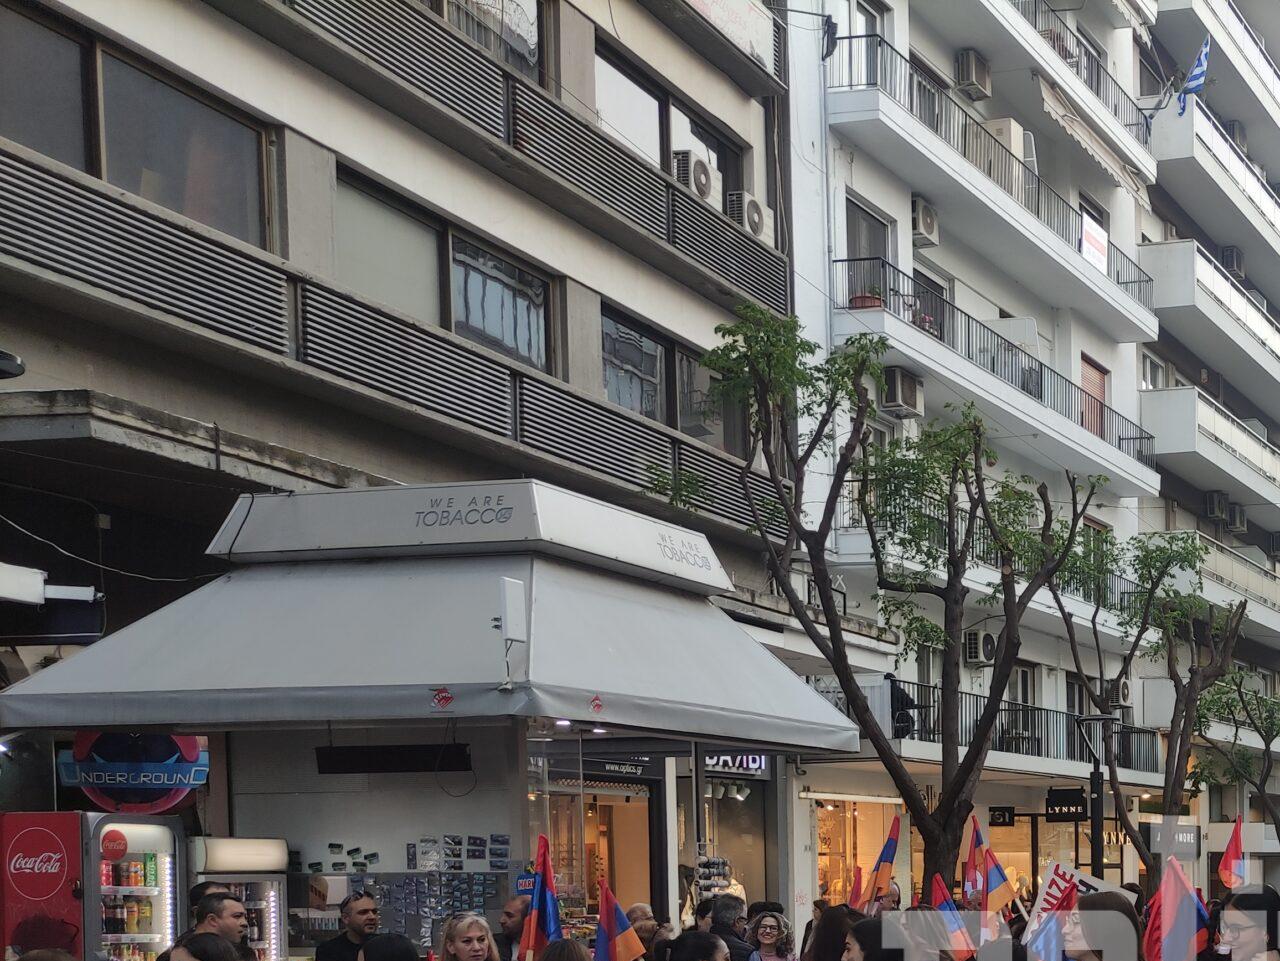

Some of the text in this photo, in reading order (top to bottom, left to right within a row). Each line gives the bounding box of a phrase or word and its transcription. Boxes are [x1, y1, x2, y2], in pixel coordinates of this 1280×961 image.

[429, 495, 505, 508] WE ARE
[415, 507, 513, 528] TOBACCO
[658, 532, 701, 553] WE ARE
[60, 762, 209, 785] UNDERGROUND
[605, 762, 644, 776] www.optics.gr
[1048, 806, 1084, 814] LYNNE
[10, 852, 64, 874] Coca-Cola
